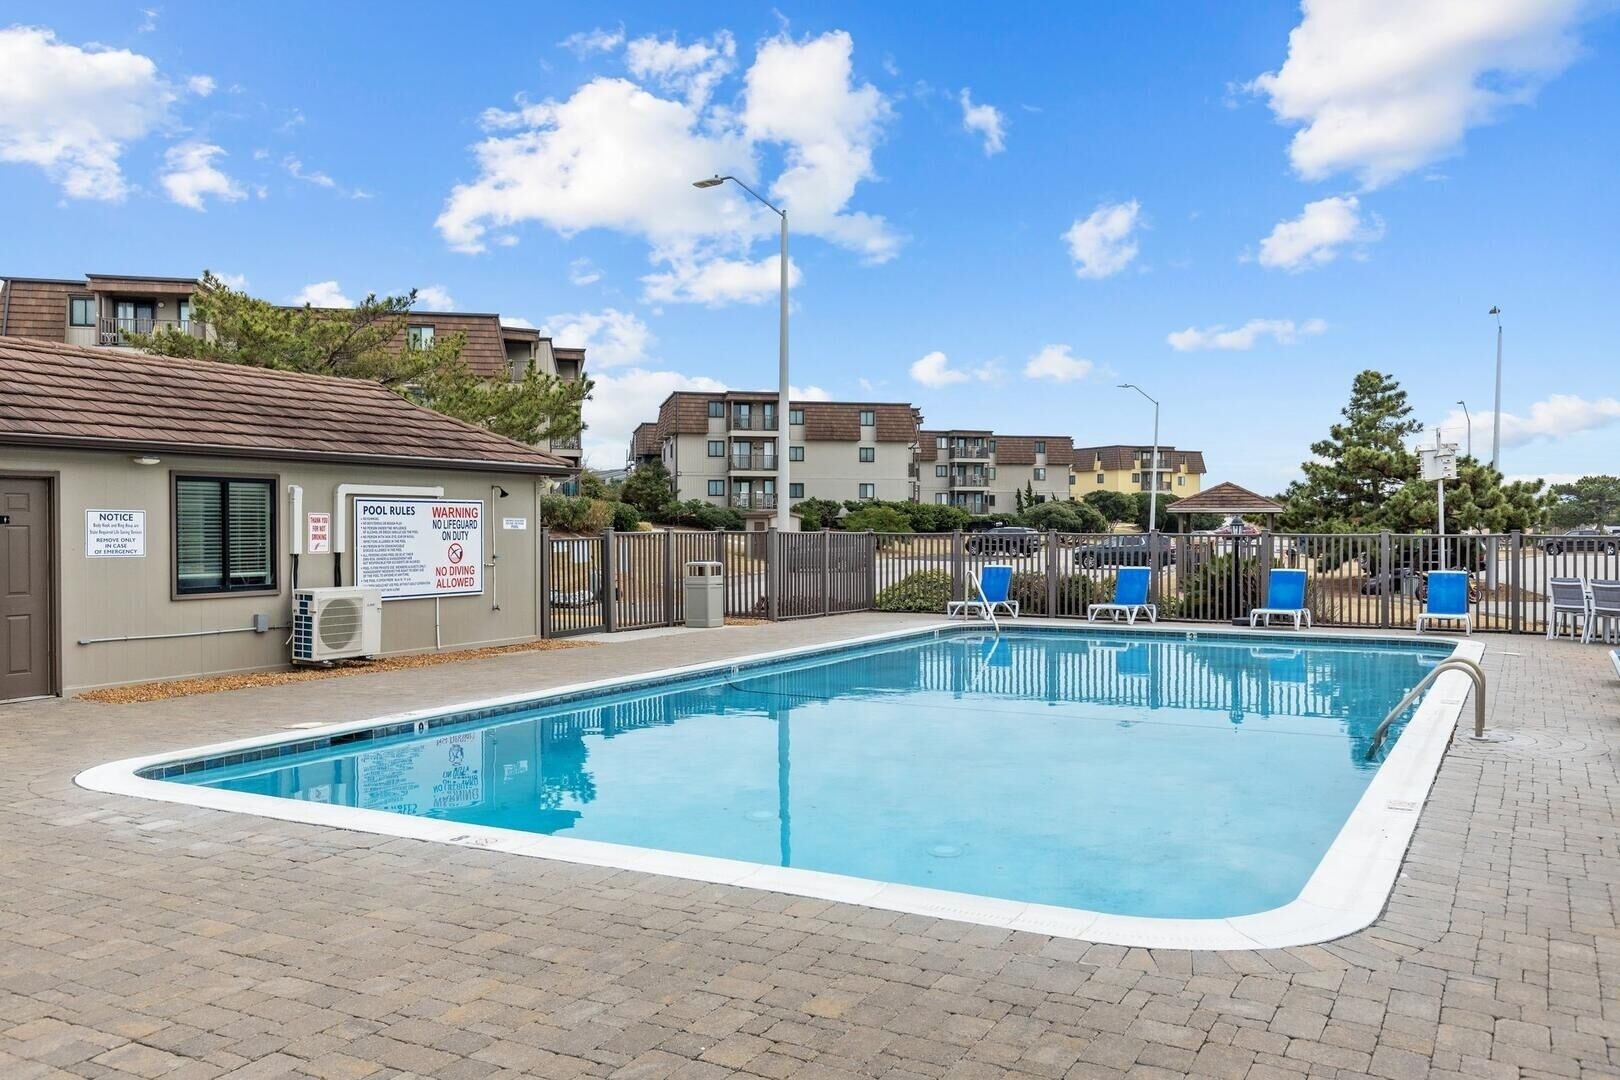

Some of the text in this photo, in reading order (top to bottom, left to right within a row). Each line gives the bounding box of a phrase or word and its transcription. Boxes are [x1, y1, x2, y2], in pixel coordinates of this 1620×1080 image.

[363, 505, 416, 516] POOL RULES
[432, 506, 478, 518] WARNING
[100, 514, 134, 522] NOTICE
[432, 520, 478, 530] NO LIFEGUARD
[442, 531, 469, 540] ON DUTY
[436, 566, 447, 576] NO
[450, 566, 475, 576] DIVING
[436, 578, 474, 588] ALLOWED
